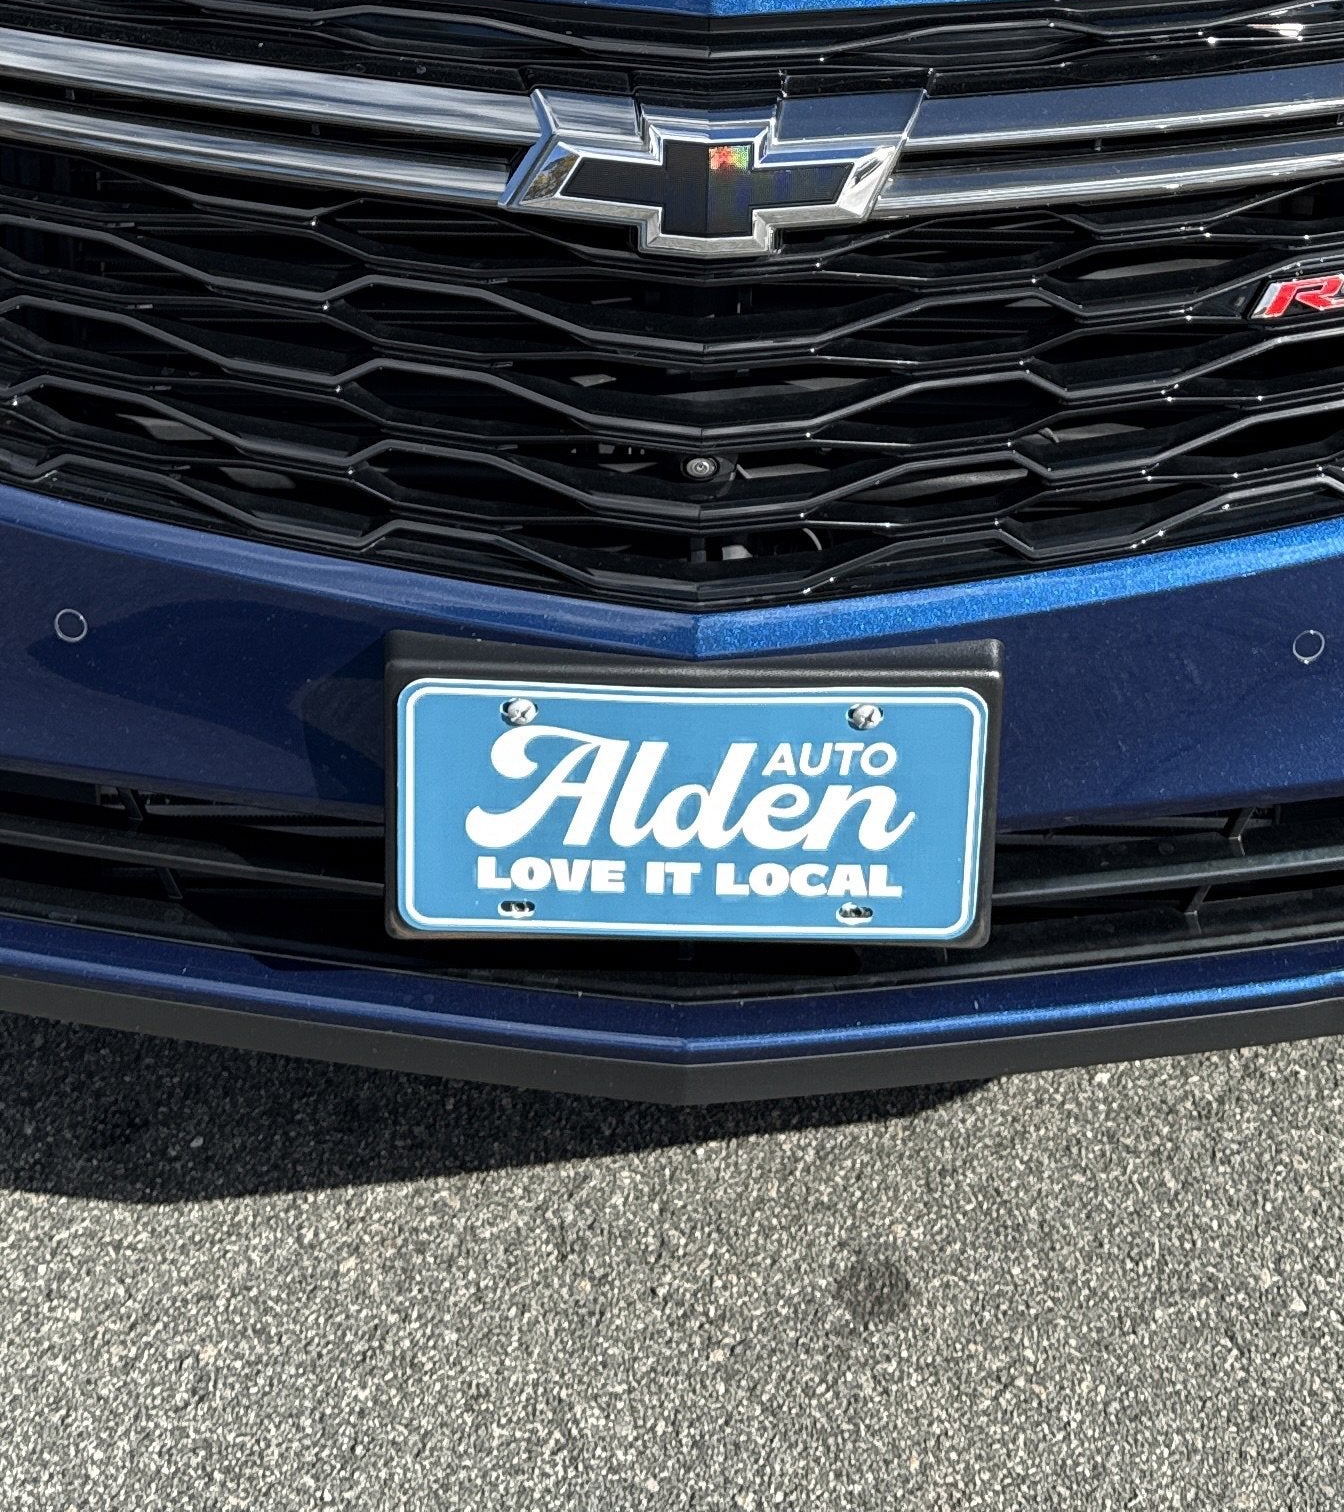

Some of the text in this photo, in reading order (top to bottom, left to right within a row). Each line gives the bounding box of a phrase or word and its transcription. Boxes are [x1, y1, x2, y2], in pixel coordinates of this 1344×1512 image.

[761, 742, 897, 776] AUTO
[465, 725, 916, 851] Alden
[476, 855, 903, 897] LOVE IT LOCAL
